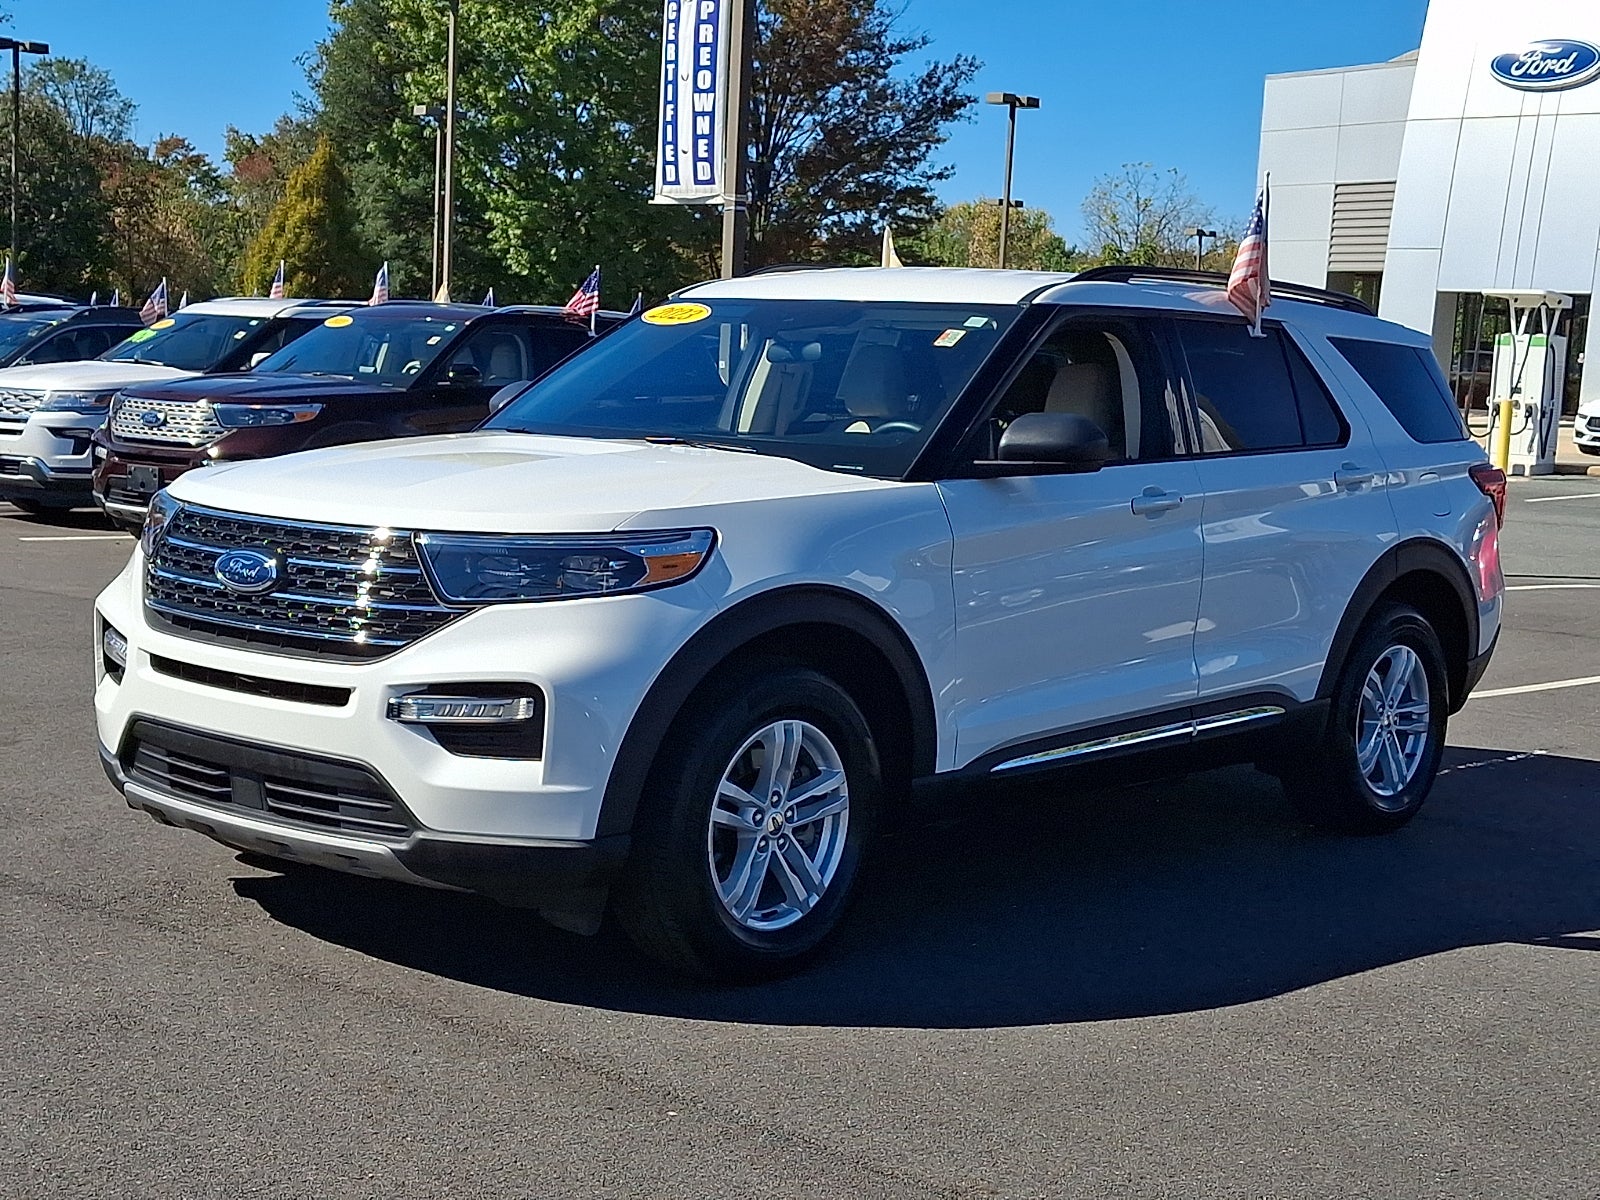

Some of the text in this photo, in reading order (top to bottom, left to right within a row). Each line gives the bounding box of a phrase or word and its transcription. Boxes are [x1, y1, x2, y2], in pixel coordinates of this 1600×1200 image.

[1510, 46, 1579, 77] Ford
[665, 1, 678, 182] CERTIFIED
[693, 0, 715, 181] PREOWNED
[648, 306, 704, 320] 2023
[225, 557, 260, 582] Ford
